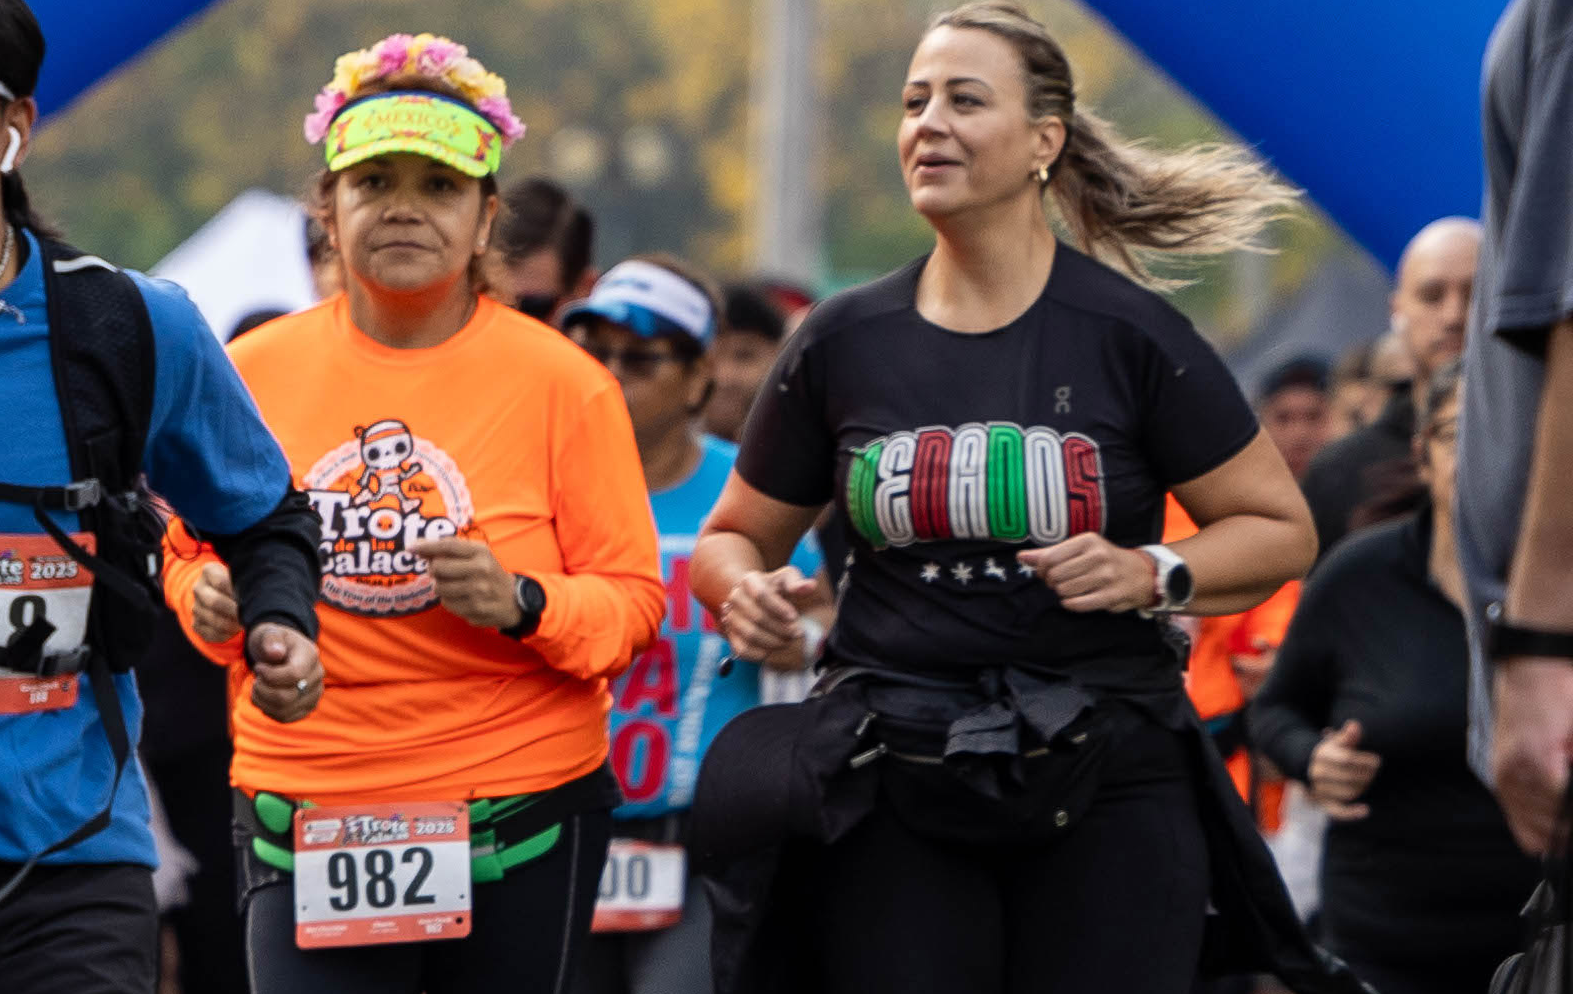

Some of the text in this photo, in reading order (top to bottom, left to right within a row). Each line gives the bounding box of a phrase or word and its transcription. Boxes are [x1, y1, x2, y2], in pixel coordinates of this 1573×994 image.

[308, 491, 456, 552] Trote
[318, 541, 430, 575] Calac
[333, 537, 395, 553] de las
[30, 561, 78, 580] 2025
[415, 821, 456, 836] 2025
[327, 846, 437, 913] 982
